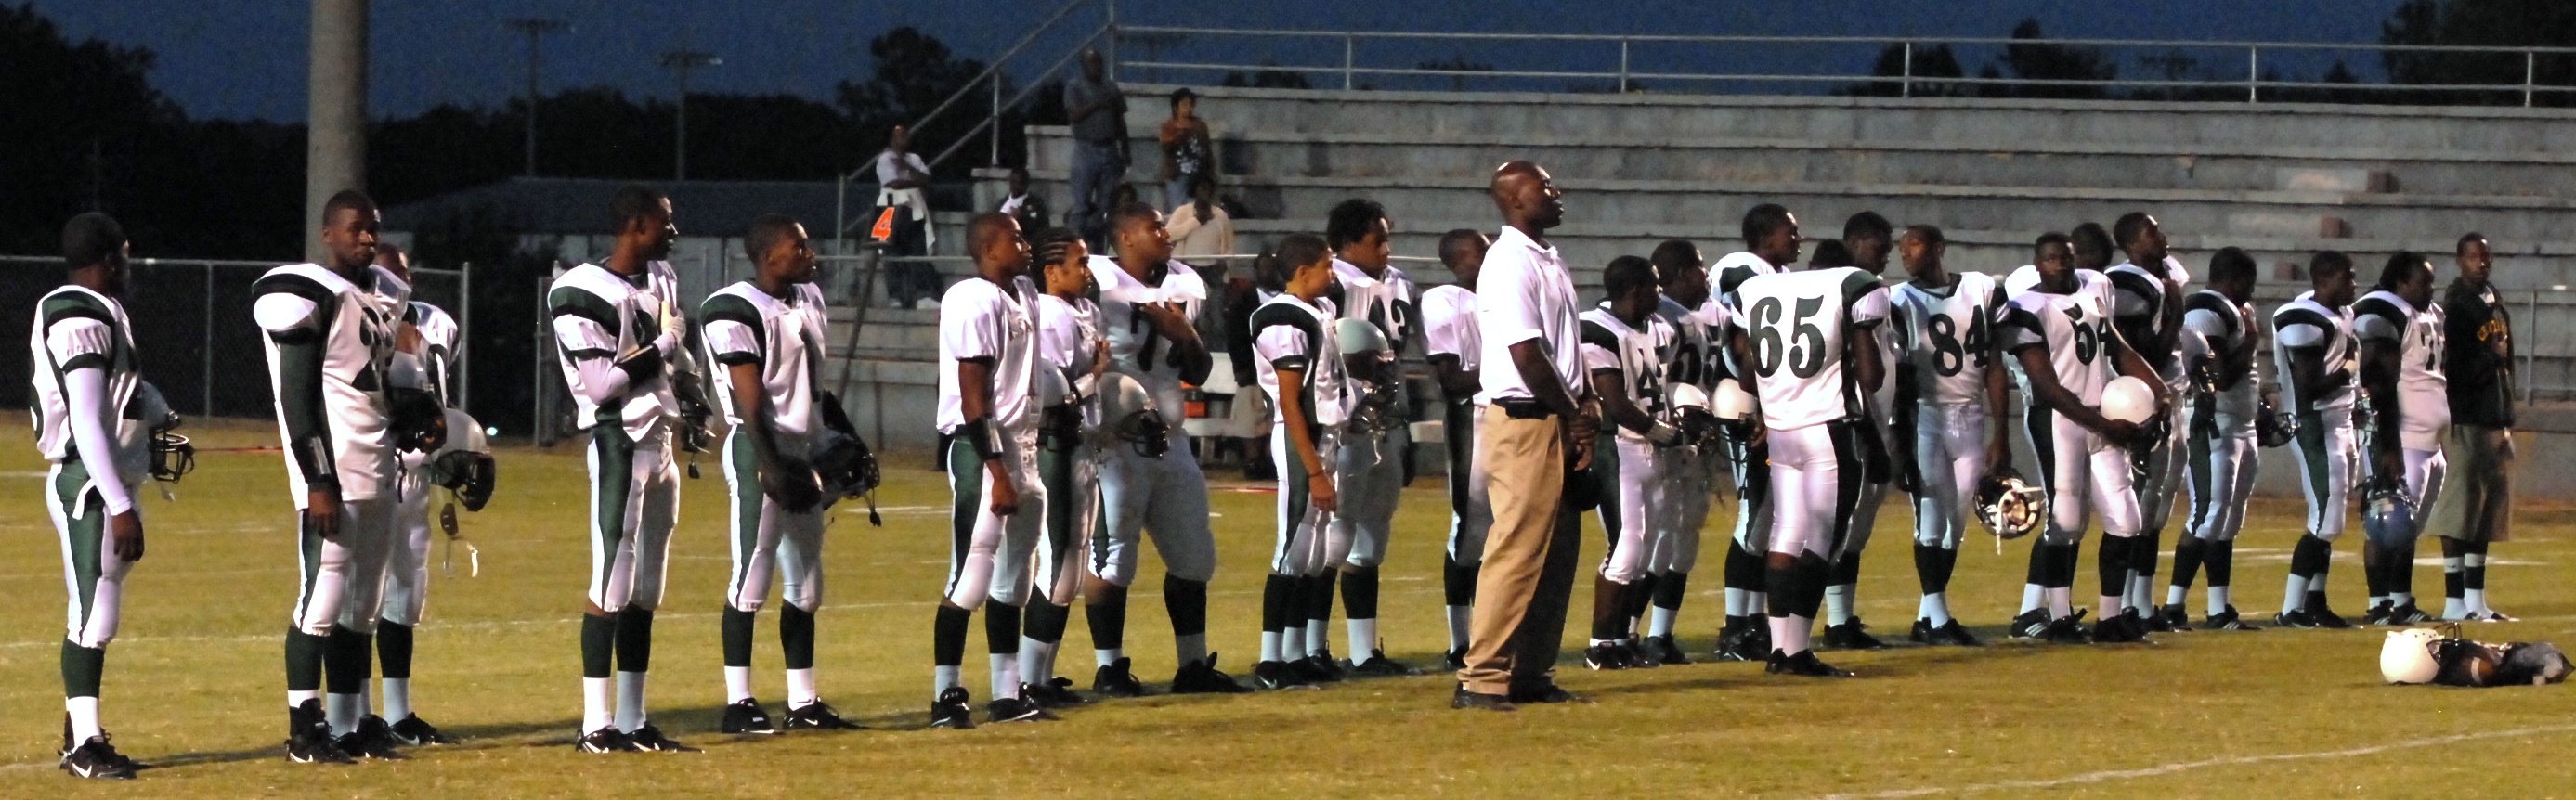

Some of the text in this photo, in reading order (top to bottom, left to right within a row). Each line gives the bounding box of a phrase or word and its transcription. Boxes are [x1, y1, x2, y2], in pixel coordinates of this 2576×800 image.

[871, 207, 894, 241] 4
[1750, 294, 1826, 379] 65
[1928, 304, 1988, 377] 84
[2062, 303, 2114, 366] 54
